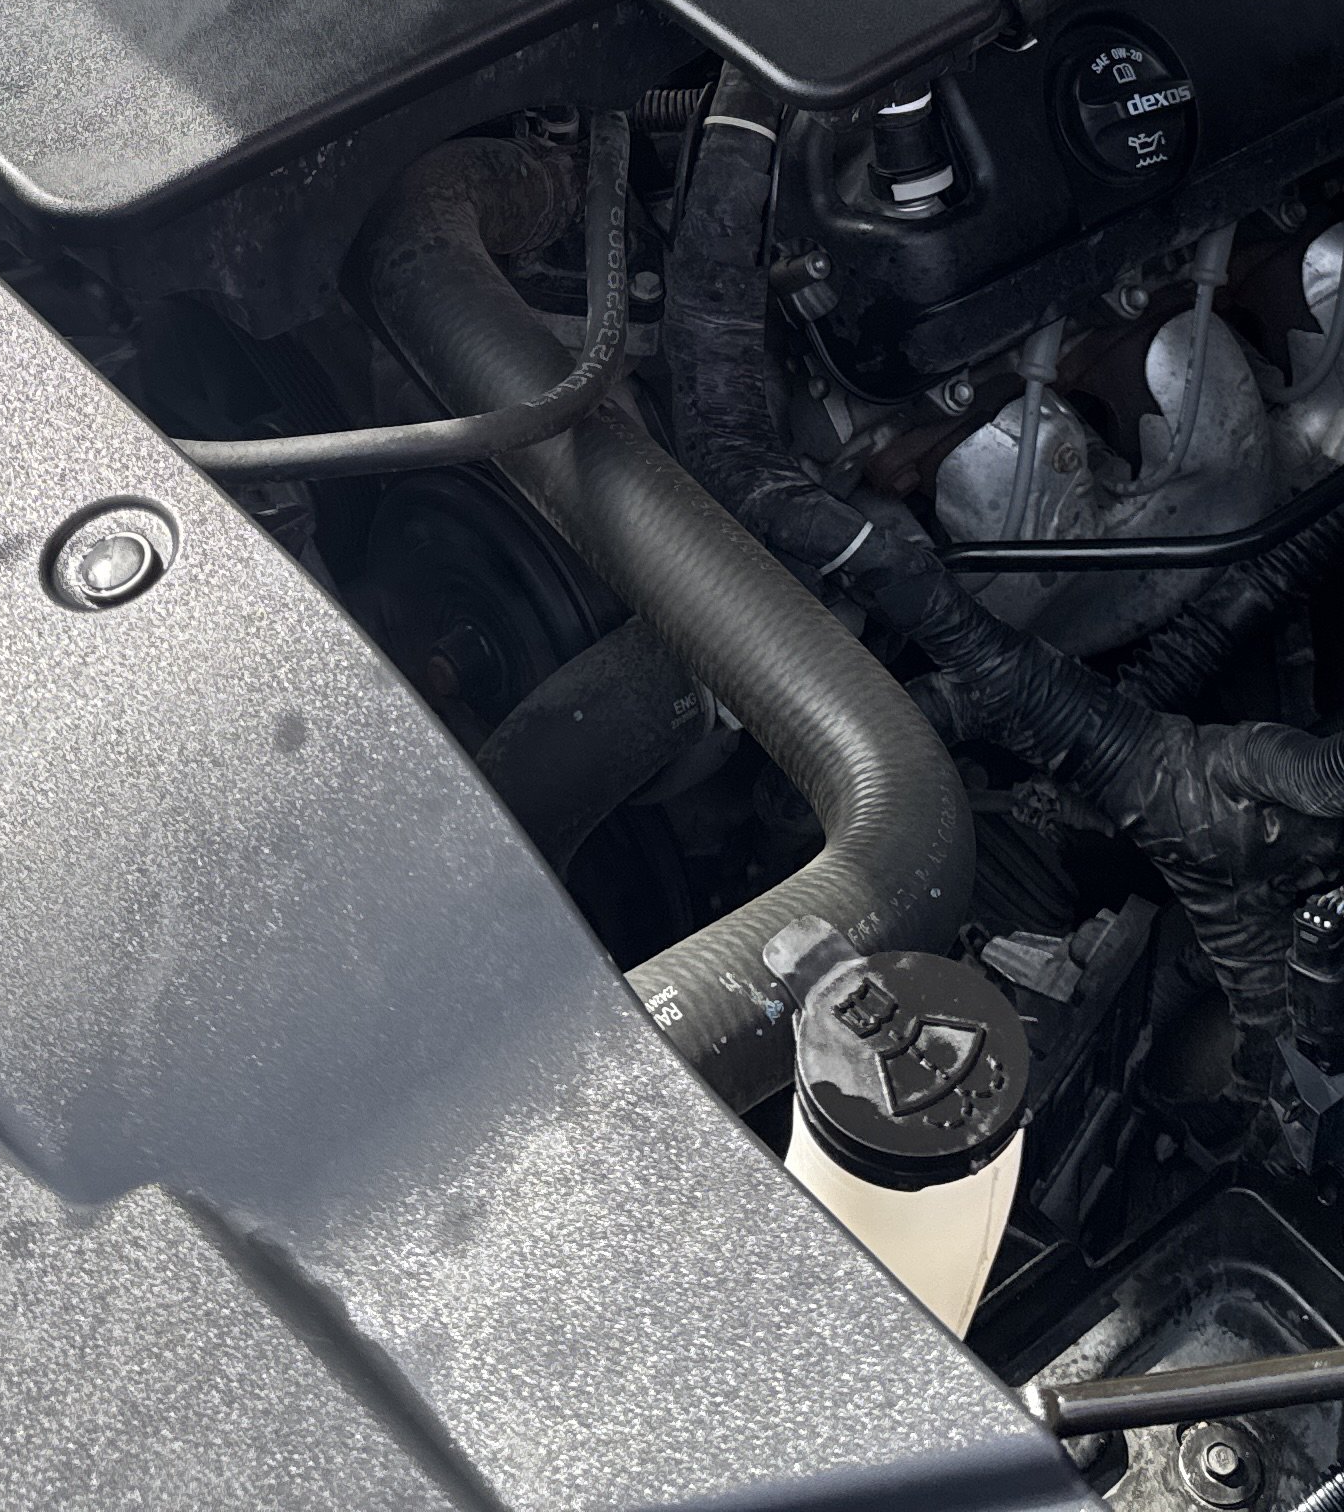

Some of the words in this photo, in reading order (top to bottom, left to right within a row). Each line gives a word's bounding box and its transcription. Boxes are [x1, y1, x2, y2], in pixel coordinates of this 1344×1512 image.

[1091, 53, 1111, 74] SAE
[1111, 47, 1143, 63] 0W-20
[1126, 85, 1192, 116] dexos
